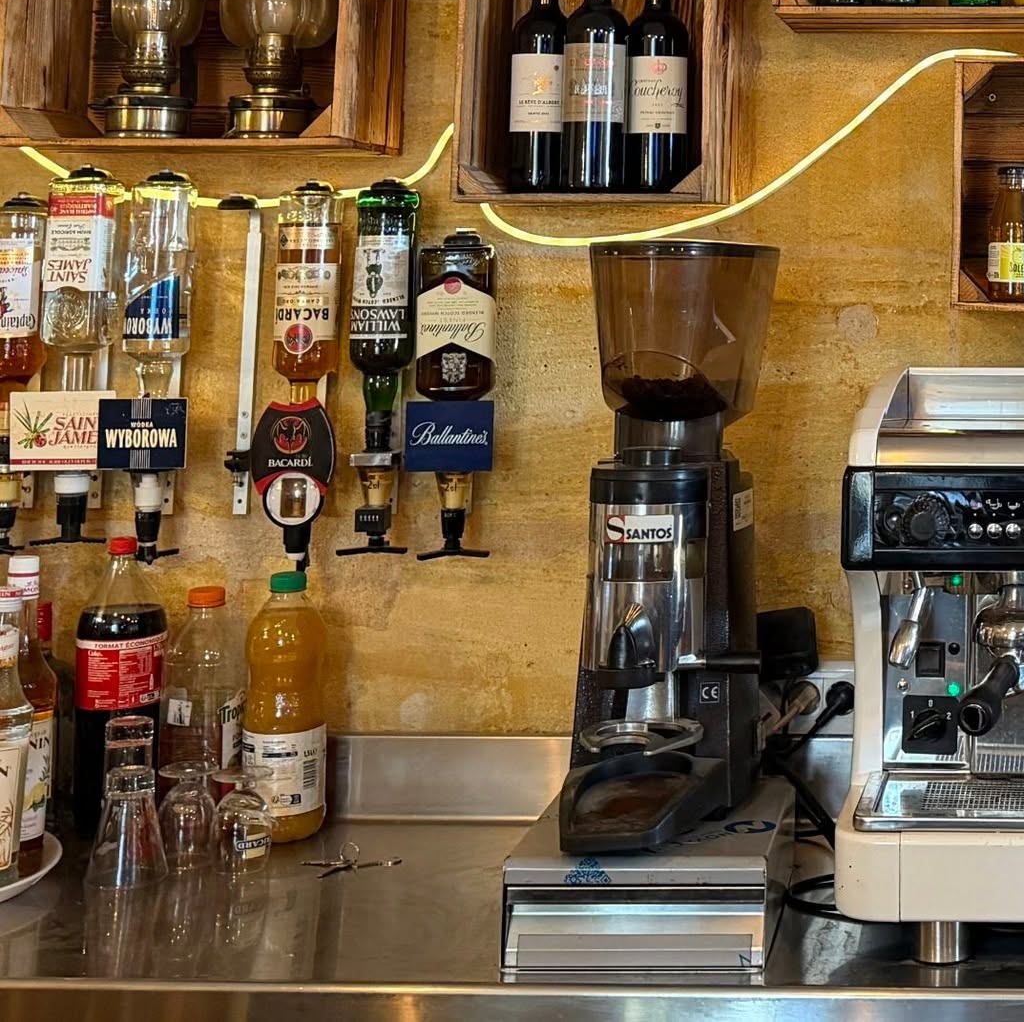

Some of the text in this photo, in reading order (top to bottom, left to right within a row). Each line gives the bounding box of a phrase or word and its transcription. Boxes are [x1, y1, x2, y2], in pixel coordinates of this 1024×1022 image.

[47, 258, 92, 271] JAMES
[47, 270, 88, 283] SAINT
[124, 317, 173, 335] WYBORO
[420, 322, 486, 343] Ballantine's
[54, 416, 97, 431] SAIN
[50, 430, 97, 445] JAME
[105, 428, 178, 448] WYBOROWA
[410, 421, 488, 446] Ballantine's
[267, 456, 313, 467] BACARDÍ
[626, 527, 672, 539] SANTOS
[702, 686, 718, 698] CE
[219, 705, 243, 724] Trop
[910, 710, 952, 720] 1 2
